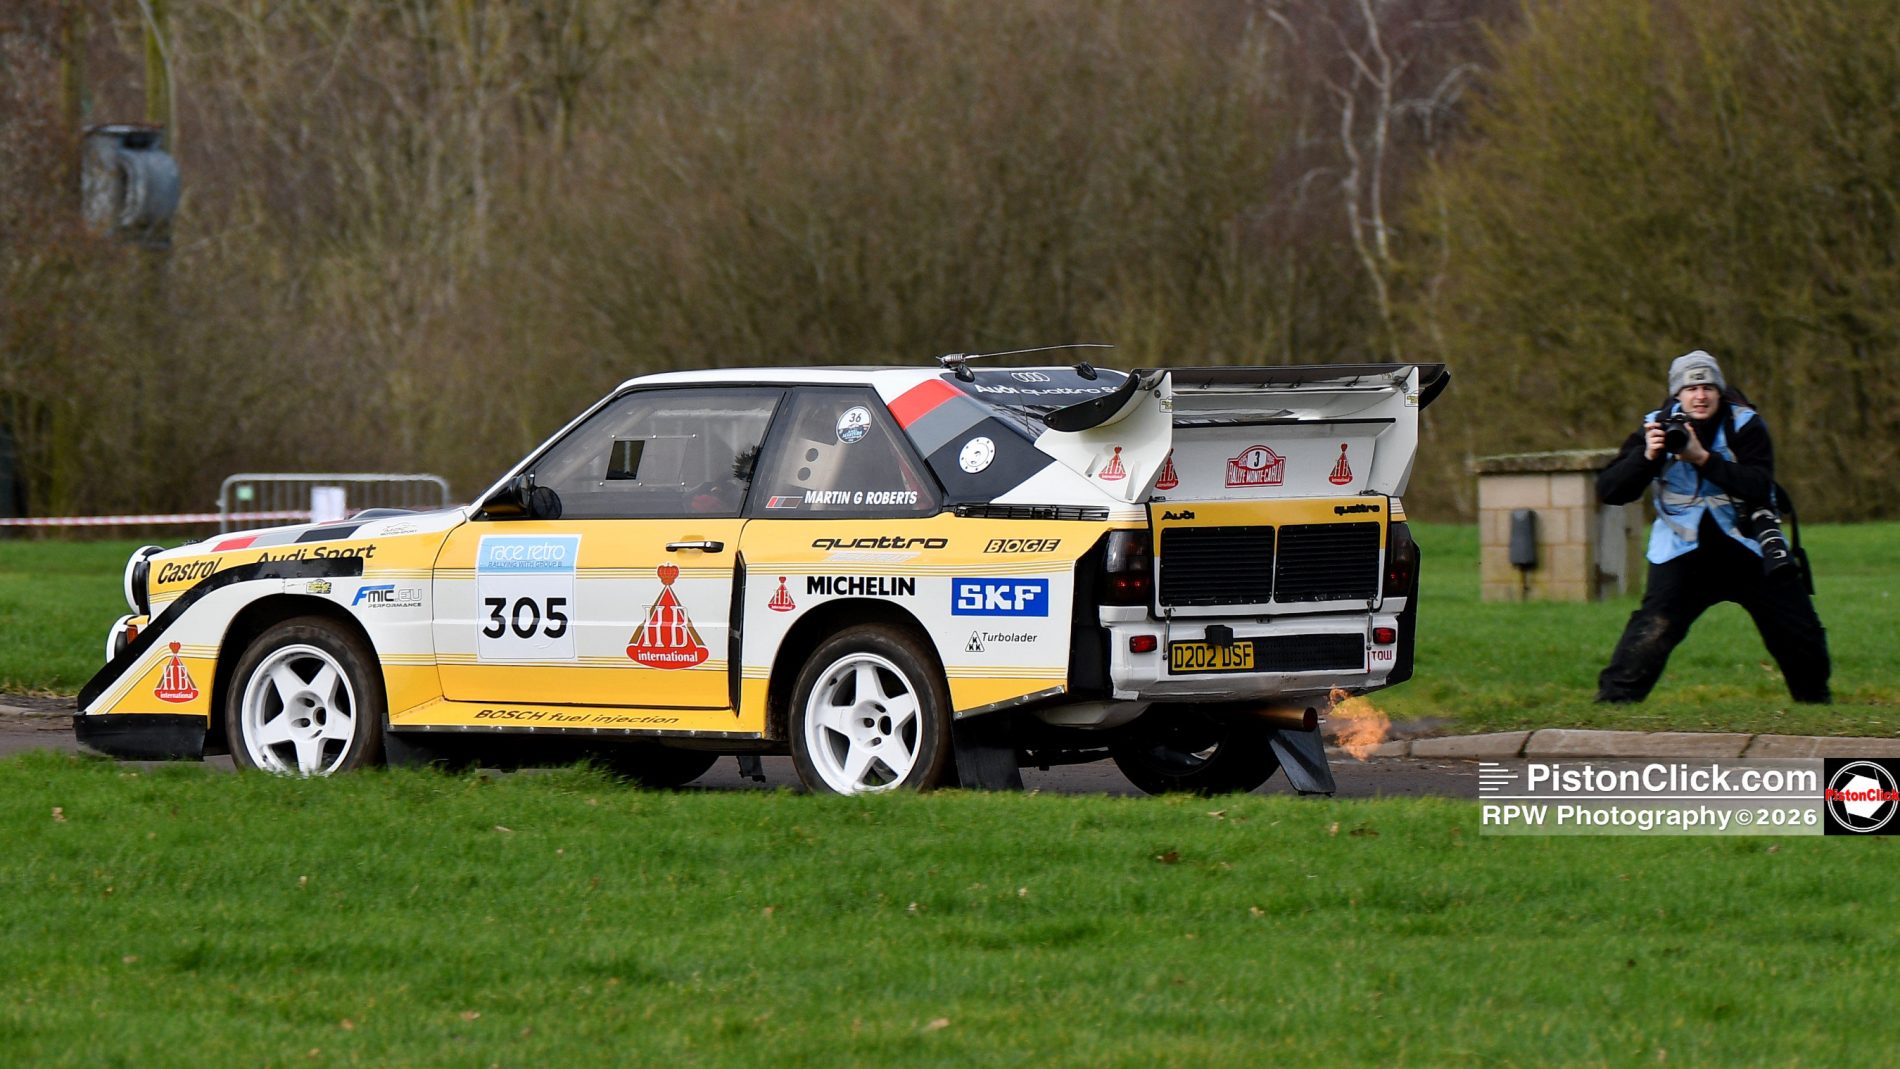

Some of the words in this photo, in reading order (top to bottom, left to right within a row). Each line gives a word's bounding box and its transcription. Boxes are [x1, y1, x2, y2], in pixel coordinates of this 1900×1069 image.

[974, 384, 1020, 394] Audi
[1020, 388, 1101, 397] quattro
[849, 412, 862, 423] 36
[1254, 451, 1260, 467] 3
[804, 490, 851, 505] MARTIN
[853, 491, 863, 505] G
[865, 490, 918, 505] ROBERTS
[1161, 510, 1195, 520] Audi
[1333, 504, 1380, 516] quattro
[811, 536, 948, 550] quattro
[984, 539, 1061, 553] BOGE
[490, 544, 525, 560] race
[528, 541, 566, 560] retro
[157, 557, 223, 585] Castrol
[535, 560, 557, 568] GROUP
[806, 576, 916, 596] MICHELIN
[957, 584, 1042, 611] SKF
[482, 596, 568, 639] 305
[641, 604, 690, 648] HB
[982, 632, 1038, 643] Turbolader
[637, 649, 699, 662] international
[1173, 645, 1217, 669] D202
[1222, 643, 1252, 667] DSF
[1371, 650, 1393, 661] TOW
[474, 709, 548, 721] BOSCH
[547, 713, 591, 722] fuel
[592, 714, 680, 724] injection
